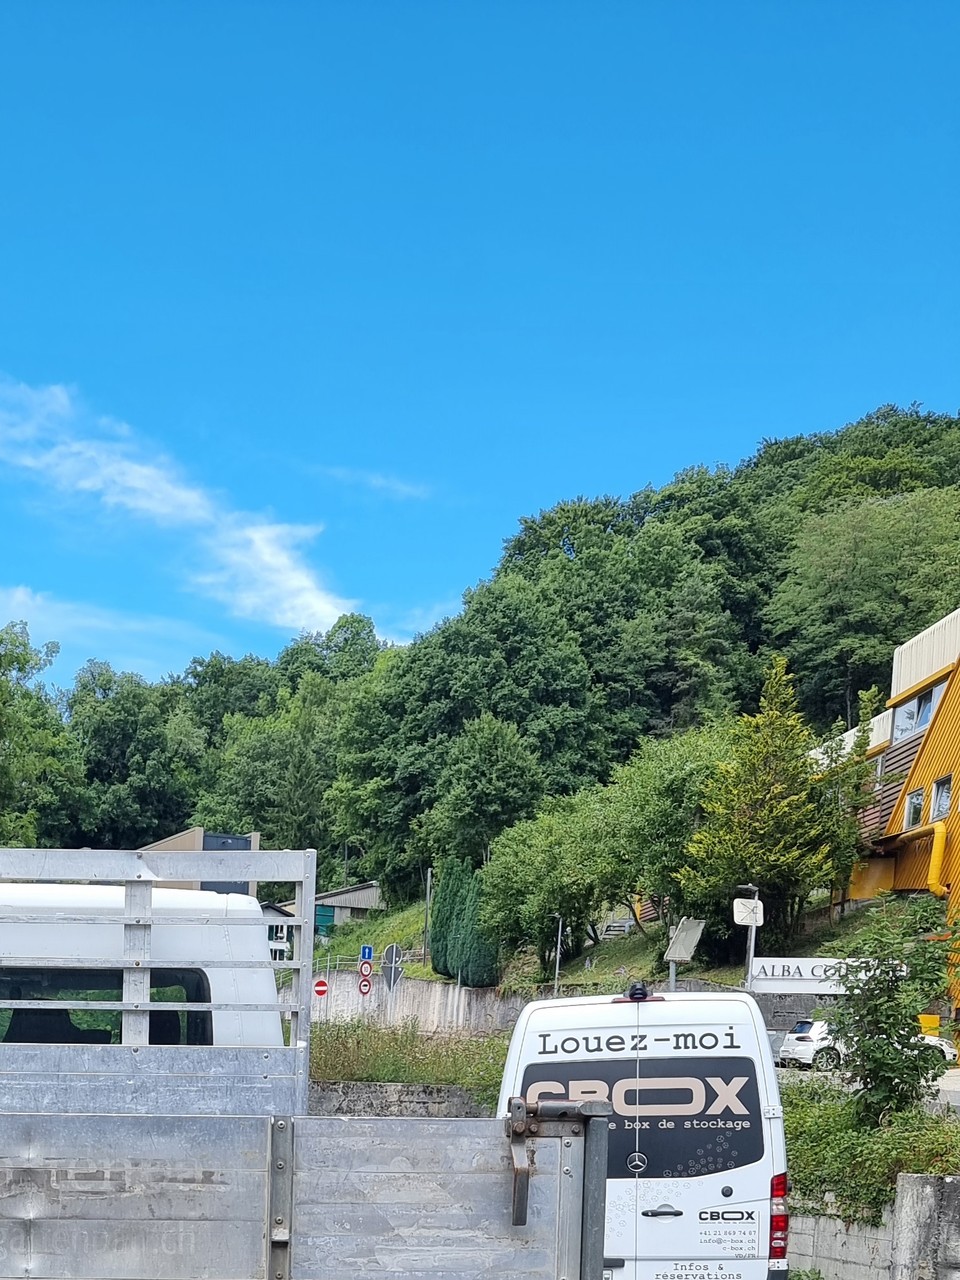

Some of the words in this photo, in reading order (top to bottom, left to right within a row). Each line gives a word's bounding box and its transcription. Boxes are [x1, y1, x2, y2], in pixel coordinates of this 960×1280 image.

[758, 965, 803, 977] ALBA
[538, 1026, 741, 1055] Louez-moi
[624, 1119, 651, 1129] box
[658, 1119, 675, 1129] de
[683, 1118, 751, 1131] stockage
[698, 1211, 756, 1221] CBOX
[673, 1262, 709, 1271] Infos
[717, 1263, 724, 1271] &
[654, 1271, 742, 1280] réservations
